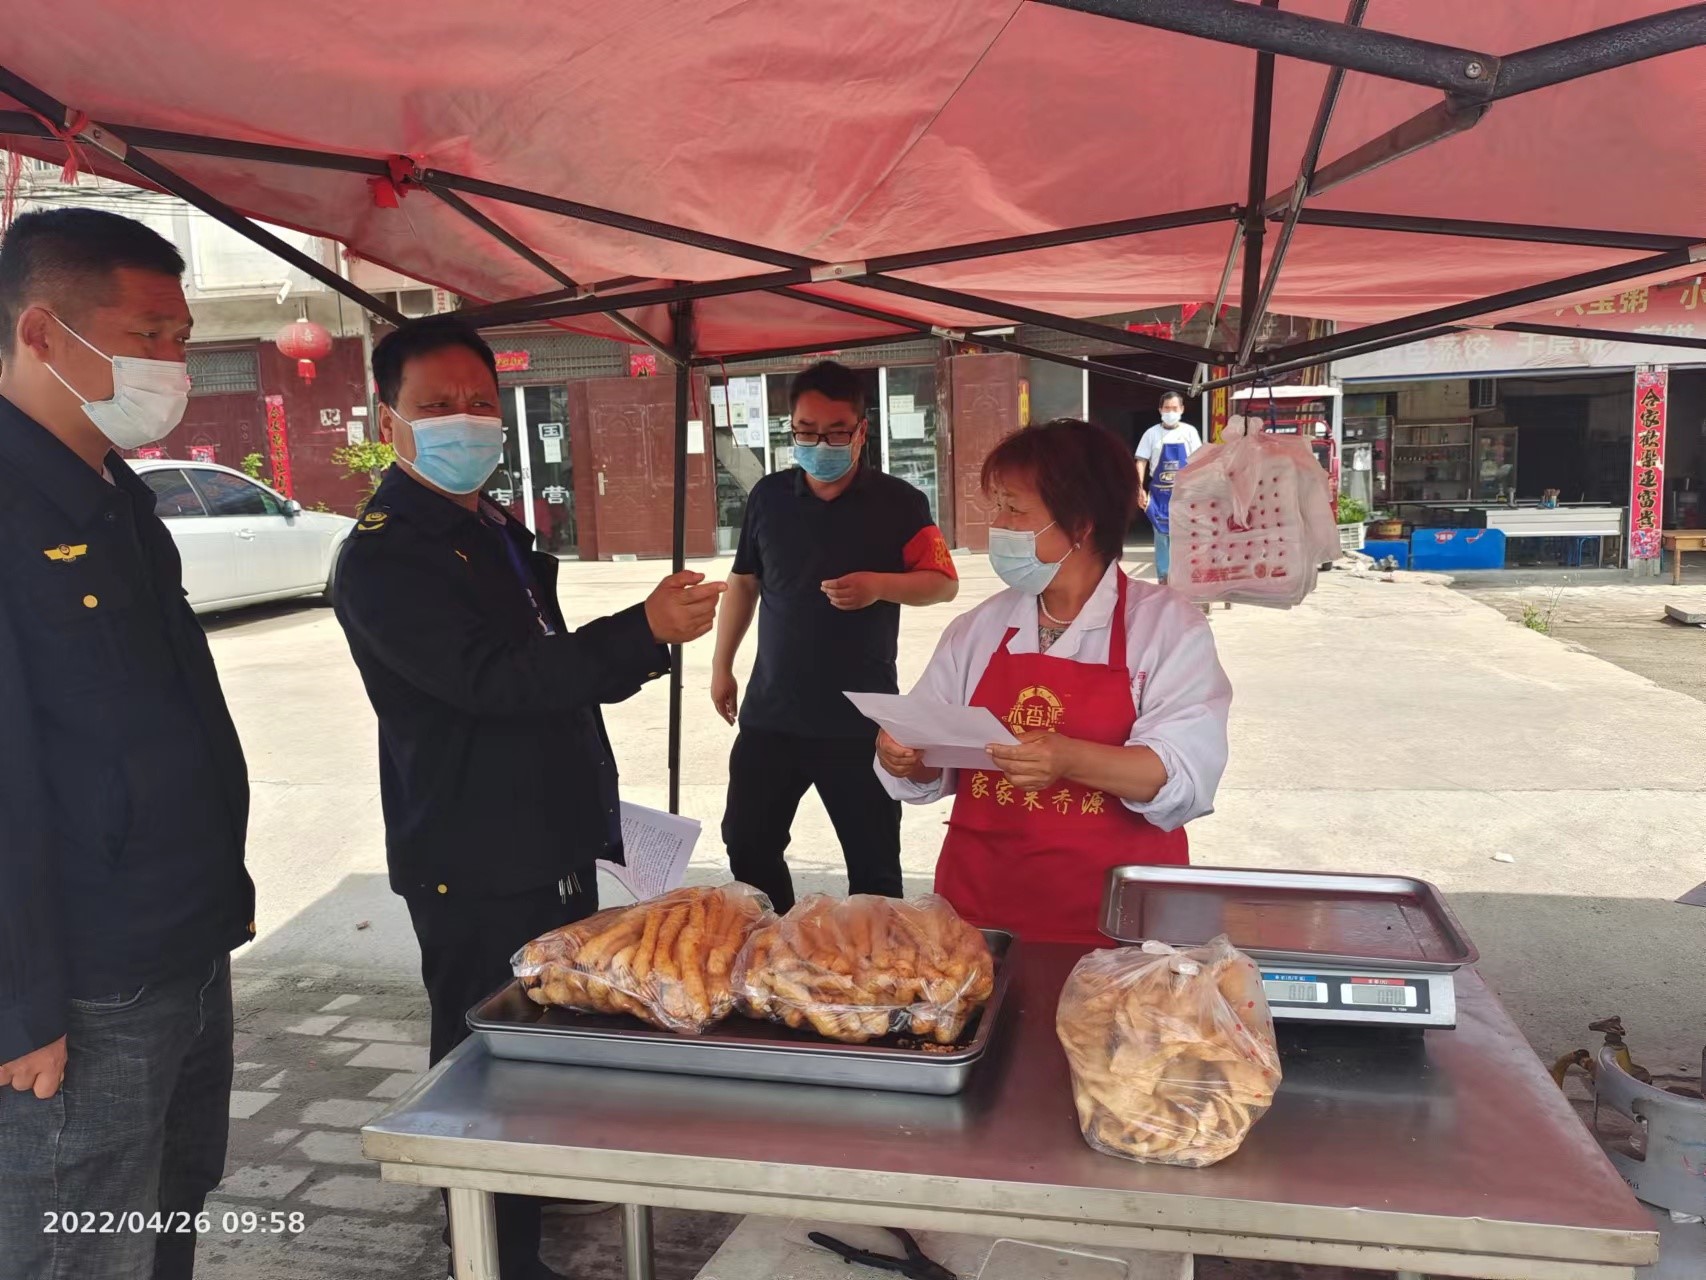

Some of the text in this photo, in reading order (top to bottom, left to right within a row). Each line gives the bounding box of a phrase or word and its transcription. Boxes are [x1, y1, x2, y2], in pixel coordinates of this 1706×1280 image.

[970, 771, 1105, 816] 家家米香源
